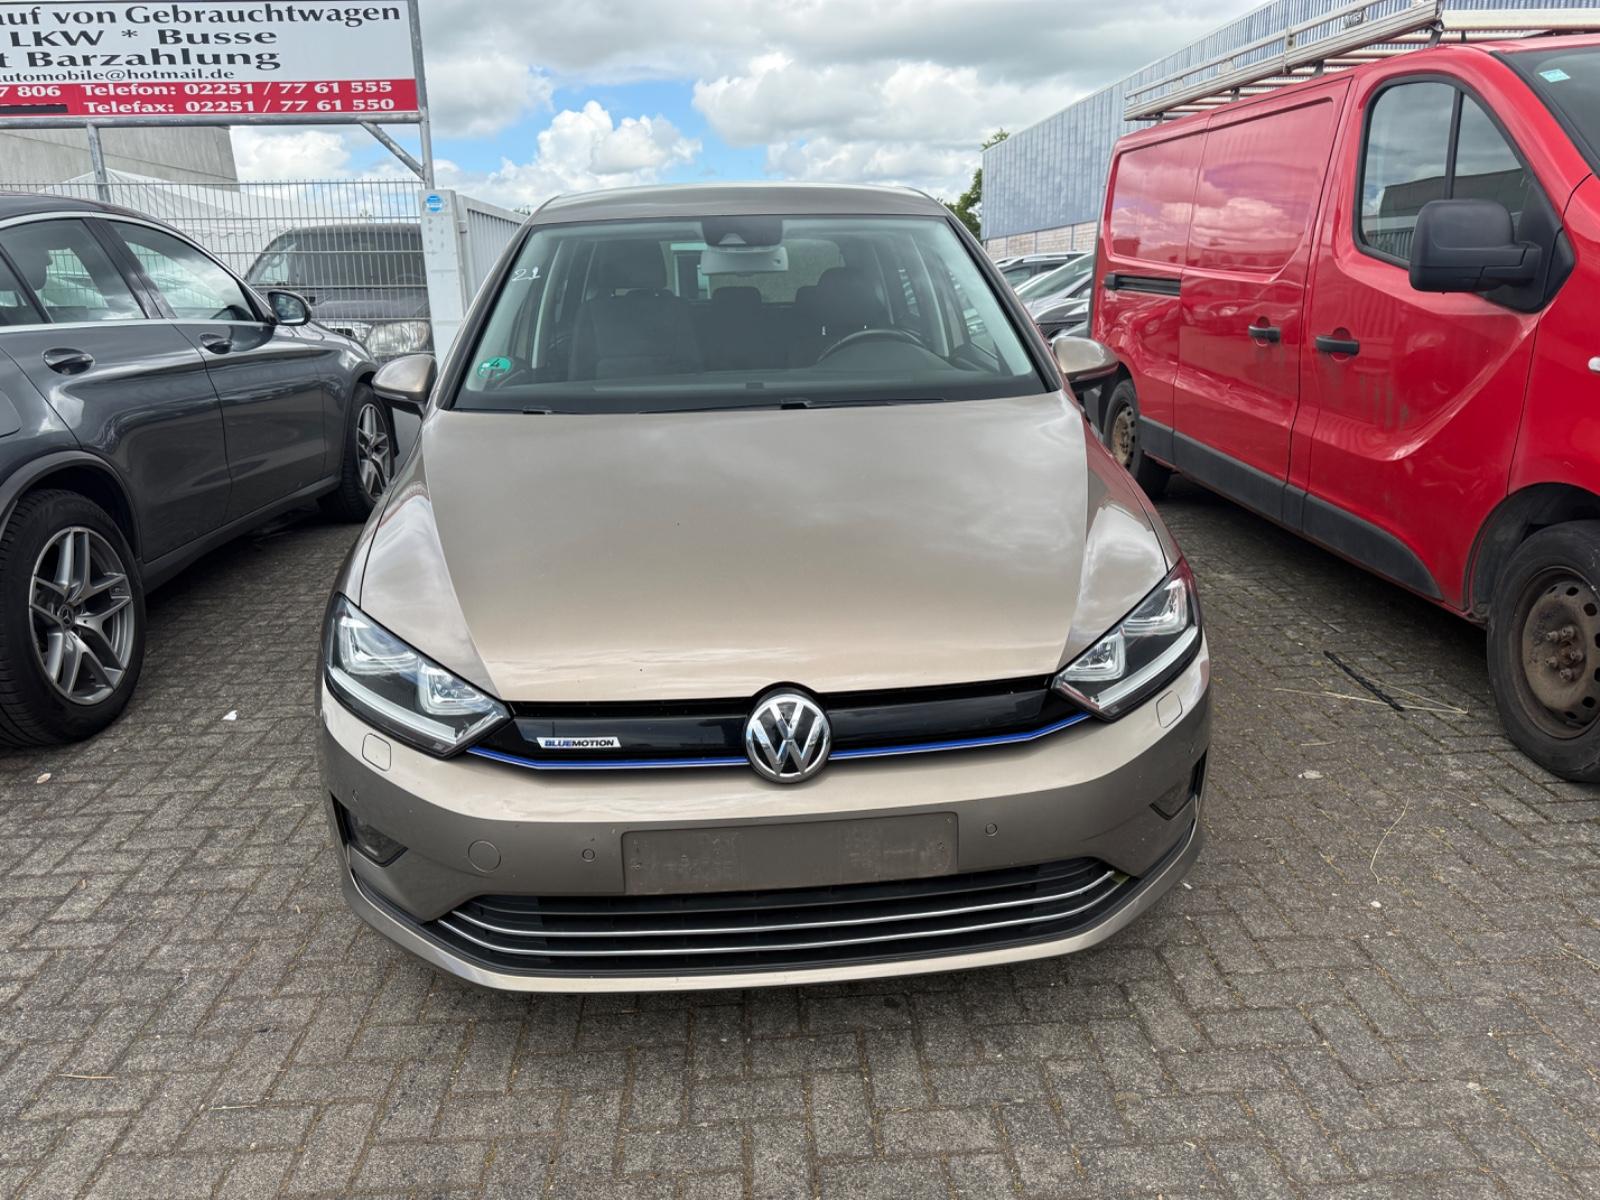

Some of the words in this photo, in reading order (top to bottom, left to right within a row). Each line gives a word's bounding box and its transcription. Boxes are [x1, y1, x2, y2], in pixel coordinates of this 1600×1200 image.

[52, 11, 117, 25] von
[125, 3, 400, 28] Gebrauchtwagen
[9, 30, 104, 47] LKW
[157, 29, 277, 45] Busse
[27, 47, 281, 71] Barzahlung
[0, 69, 235, 83] utomobile@hotmail.de
[17, 85, 62, 98] 806
[80, 84, 177, 97] Telefon:
[184, 83, 254, 95] 02251
[279, 83, 308, 94] 77
[314, 82, 340, 94] 61
[351, 82, 393, 93] 555
[83, 100, 175, 114] Telefax:
[185, 100, 255, 113] 02251
[280, 100, 308, 111] 77
[316, 100, 342, 111] 61
[353, 99, 396, 111] 550
[544, 739, 615, 747] BLUEMOTION
